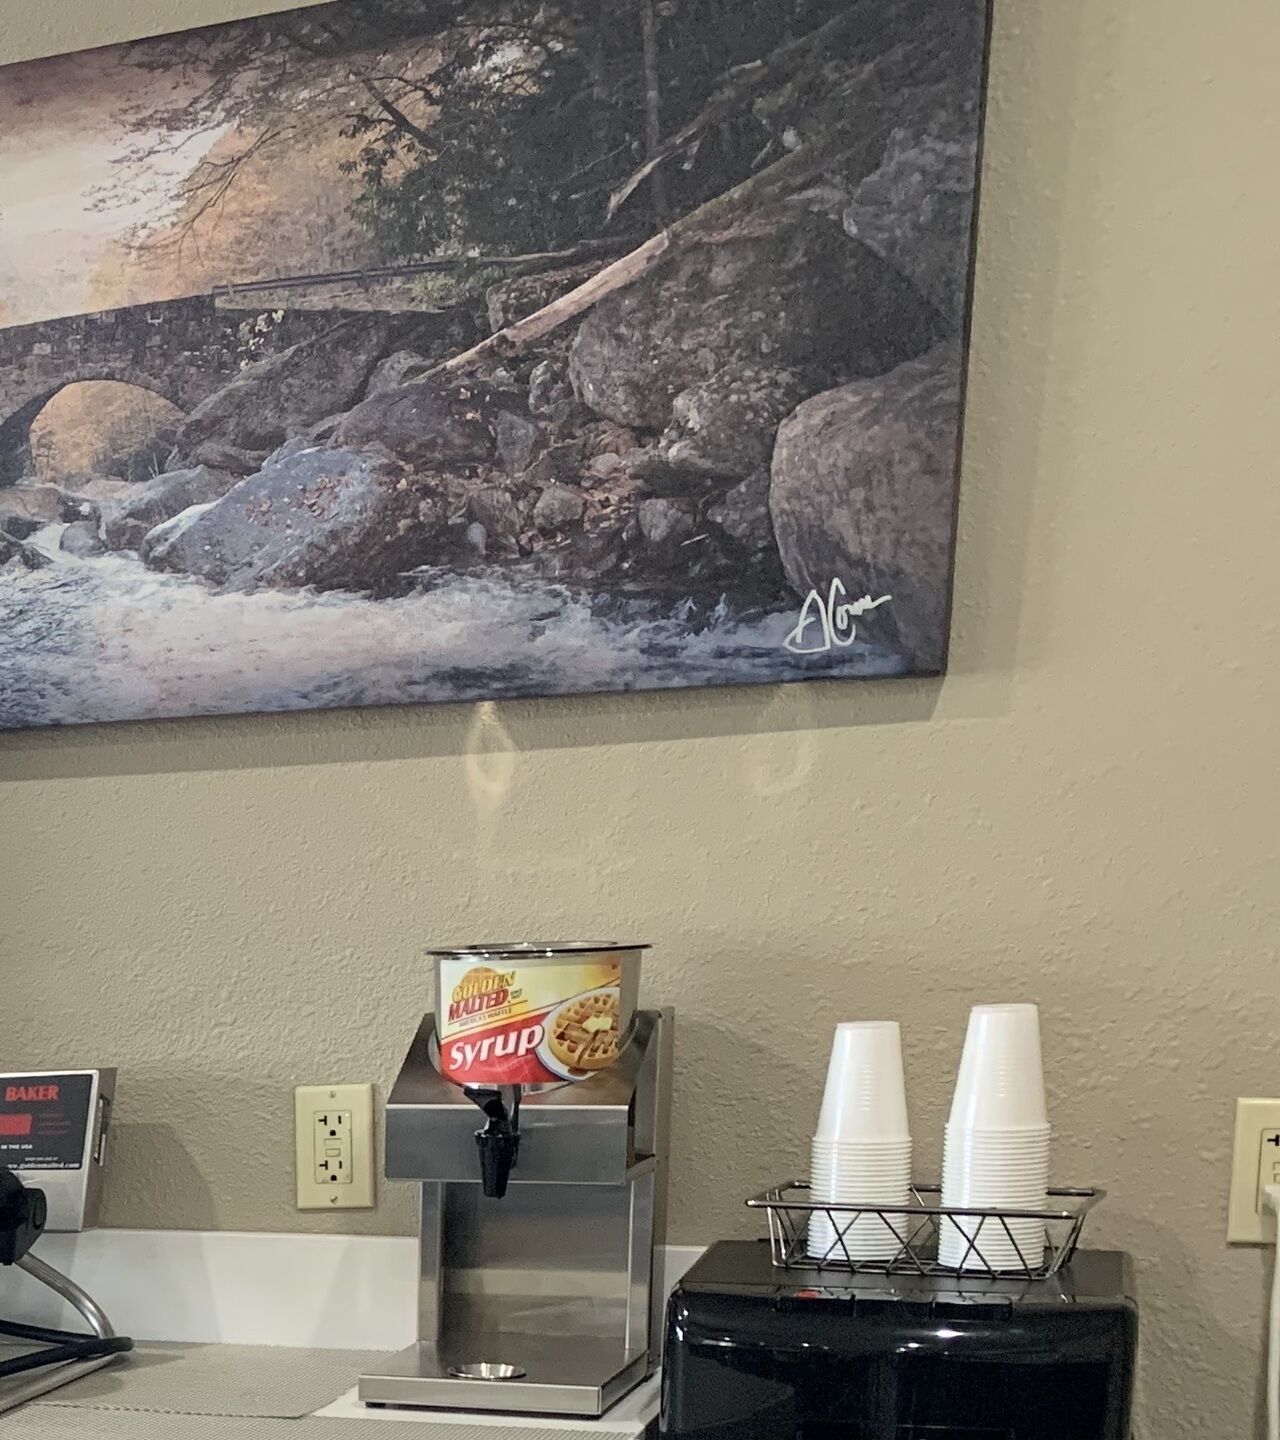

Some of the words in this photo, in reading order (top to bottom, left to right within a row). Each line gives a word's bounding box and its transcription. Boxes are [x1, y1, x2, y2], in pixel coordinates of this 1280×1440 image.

[452, 970, 516, 1003] GOLDEN
[448, 988, 509, 1022] MALTED
[487, 1008, 512, 1019] WAFFLE
[449, 1024, 544, 1071] Syrup
[5, 1085, 59, 1102] BAKER
